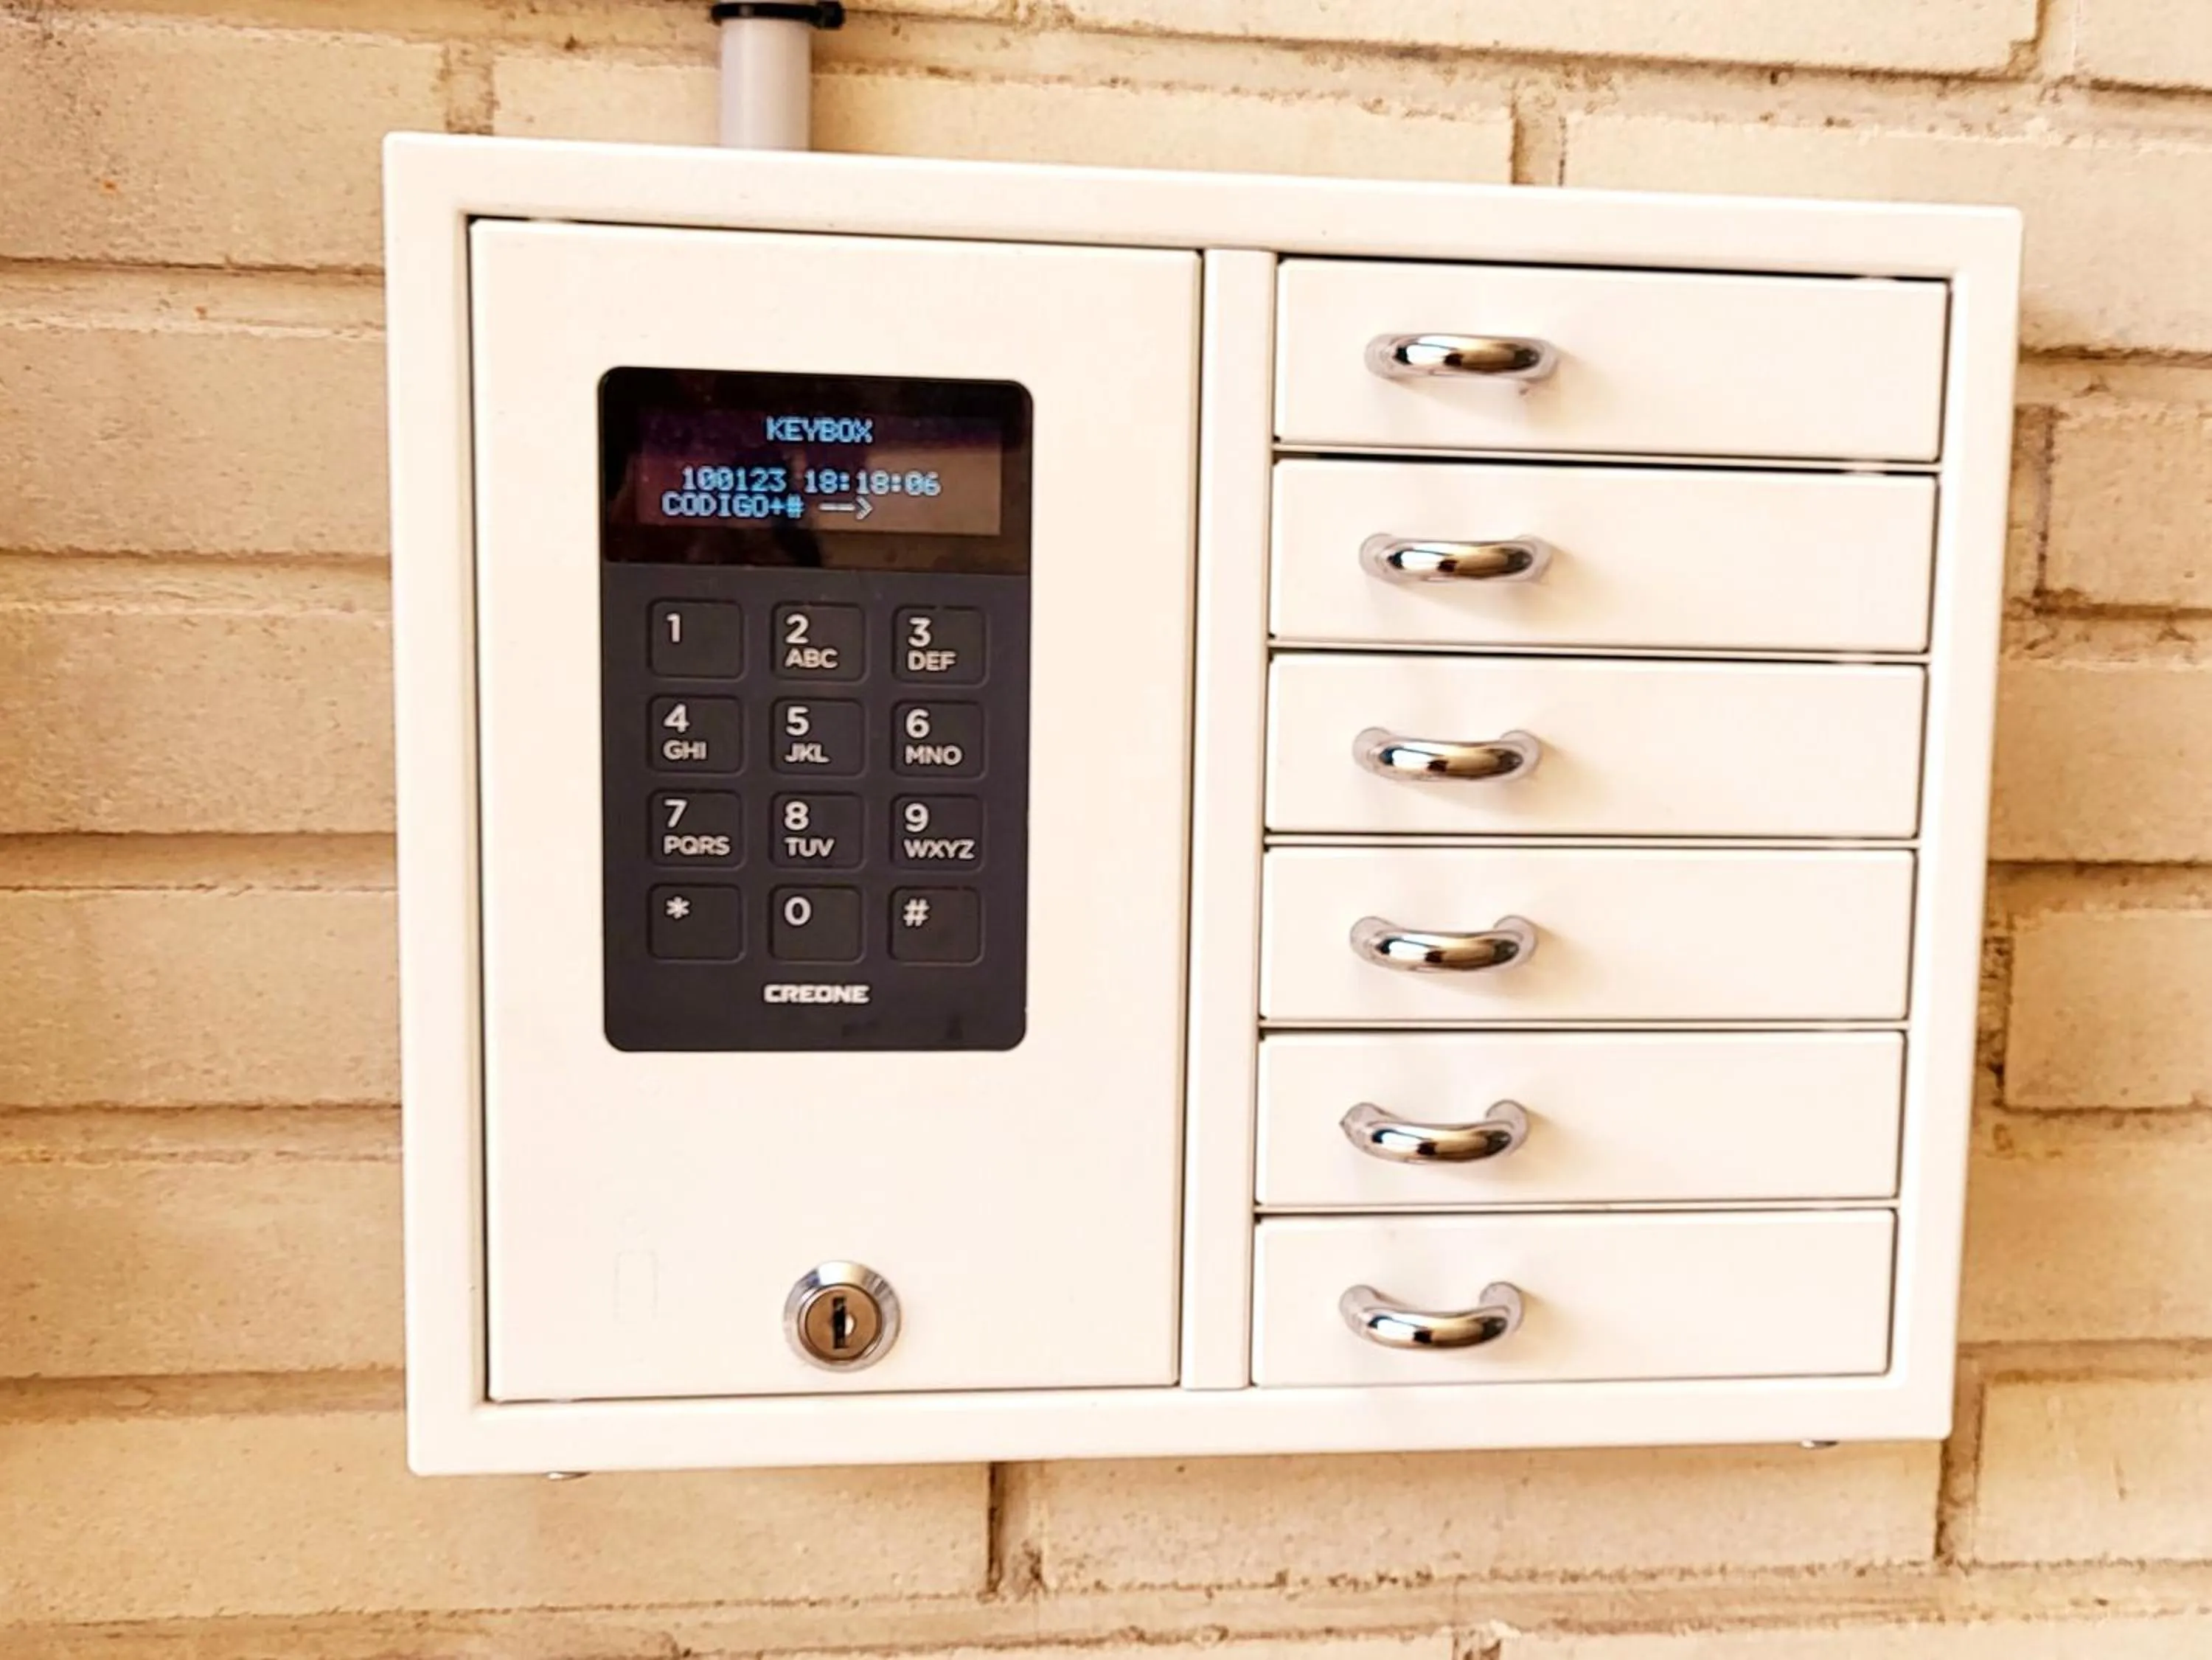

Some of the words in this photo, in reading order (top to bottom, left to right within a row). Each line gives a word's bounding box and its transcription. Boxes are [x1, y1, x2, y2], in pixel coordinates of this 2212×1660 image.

[766, 416, 873, 443] KEYBOX
[682, 465, 787, 492] 100123
[804, 470, 942, 496] 18:18:06
[667, 613, 681, 642] 1
[786, 614, 809, 644] 2
[908, 617, 931, 647] 3
[785, 648, 838, 669] ABC
[908, 650, 956, 672] DEF
[664, 704, 689, 733] 4
[786, 706, 809, 736] 5
[906, 708, 930, 739] 6
[663, 739, 706, 760] GHI
[785, 743, 830, 763] JKL
[905, 745, 962, 766] MNO
[665, 799, 687, 828] 7
[785, 801, 809, 831] 8
[905, 803, 929, 832] 9
[664, 835, 730, 856] PQRS
[785, 837, 835, 857] TUV
[904, 840, 975, 859] WXYZ
[785, 896, 811, 926] 0
[764, 984, 869, 1003] CREONE
